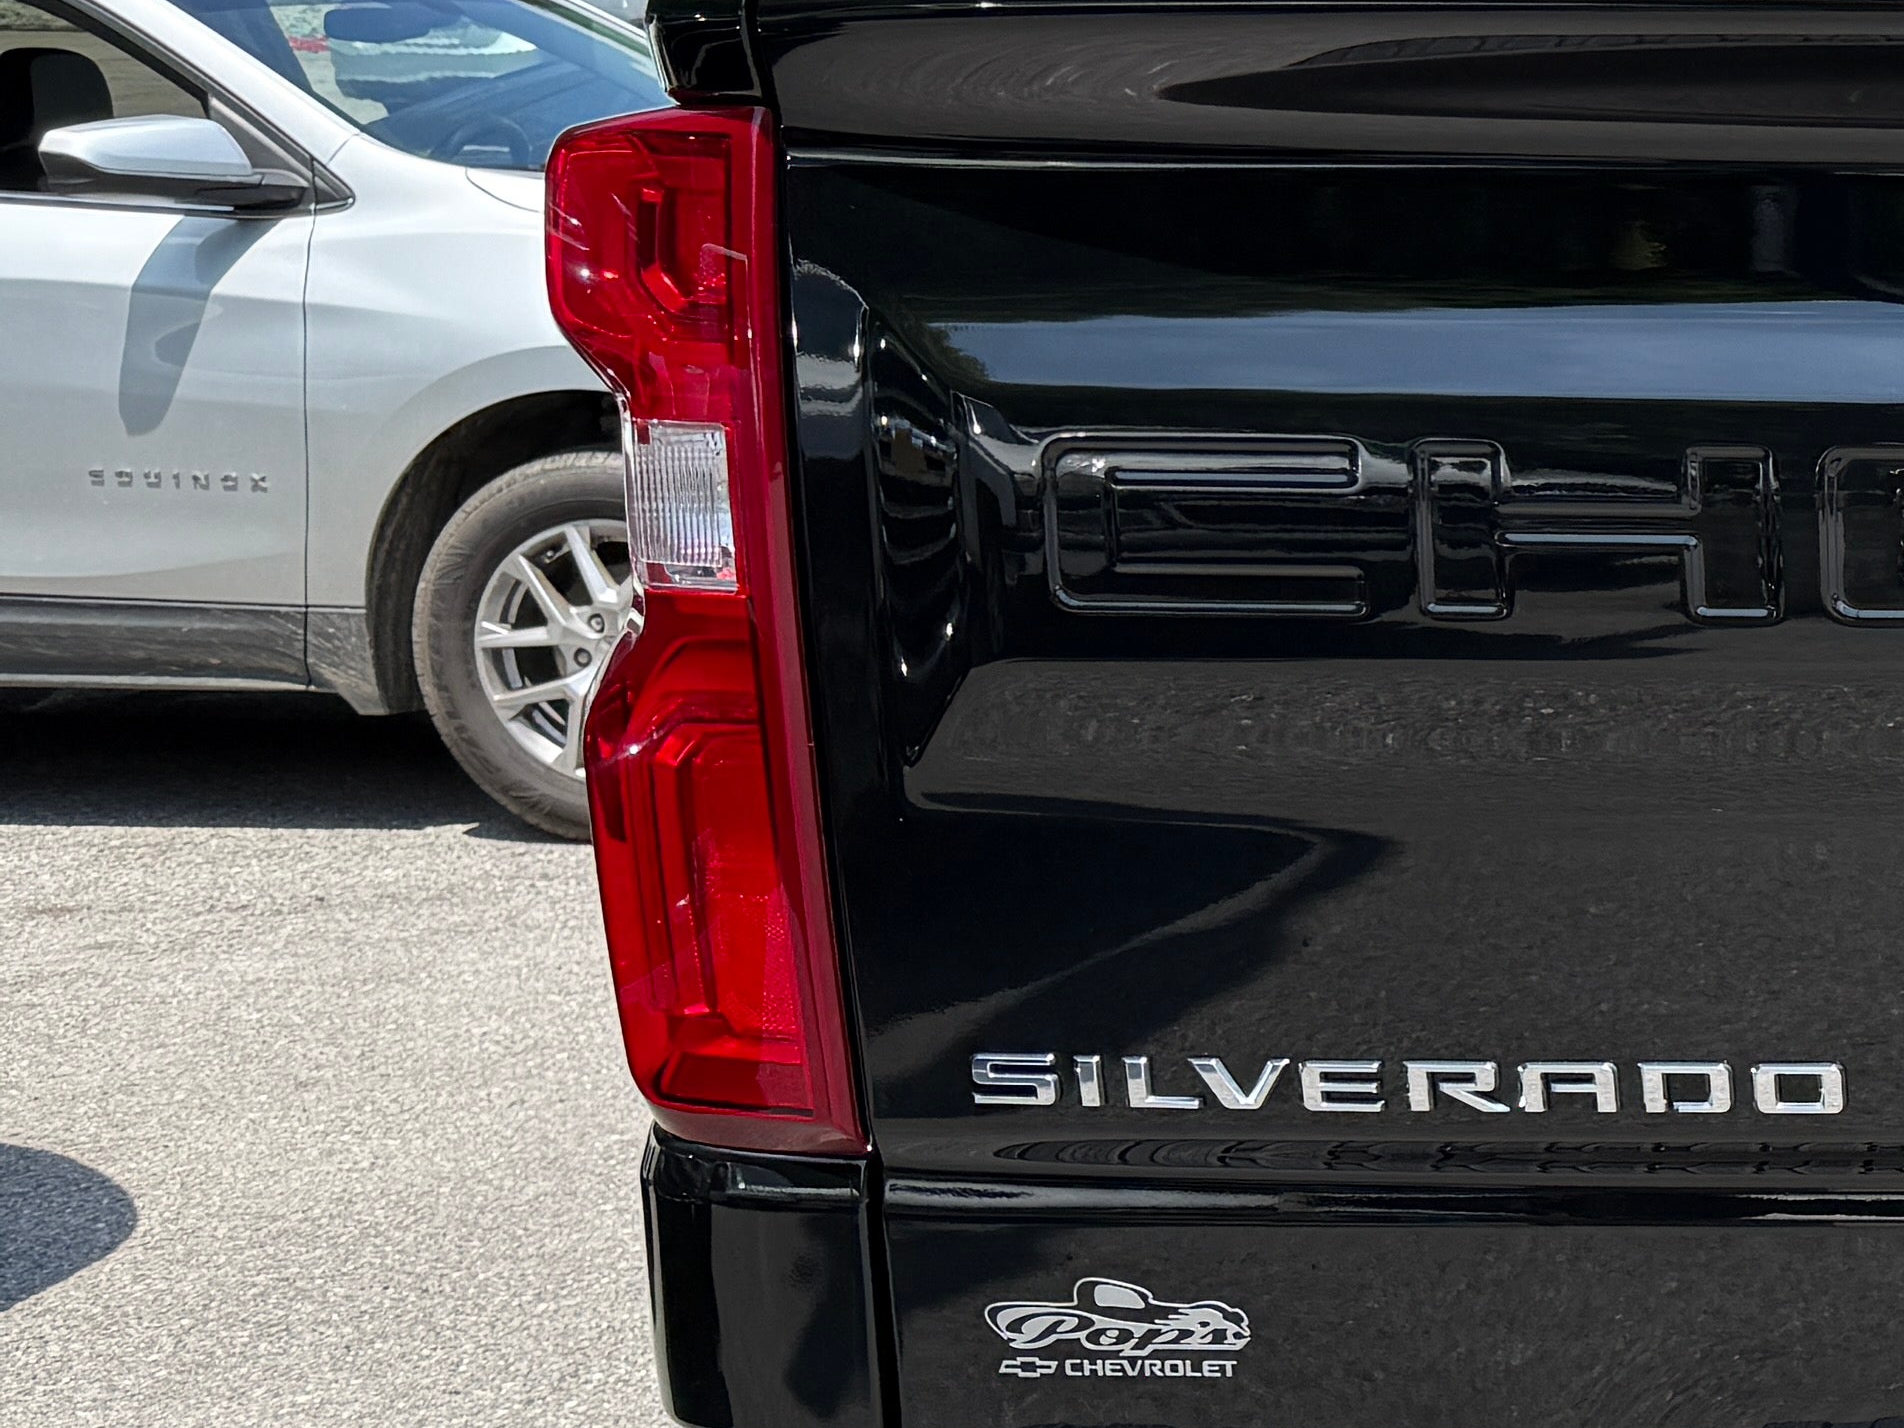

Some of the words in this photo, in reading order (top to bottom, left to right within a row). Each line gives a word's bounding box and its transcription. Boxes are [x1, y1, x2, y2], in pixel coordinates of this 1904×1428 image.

[87, 467, 270, 494] EQUINOX
[969, 1051, 1849, 1114] SILVERADO
[1063, 1358, 1238, 1377] CHEVROLET
